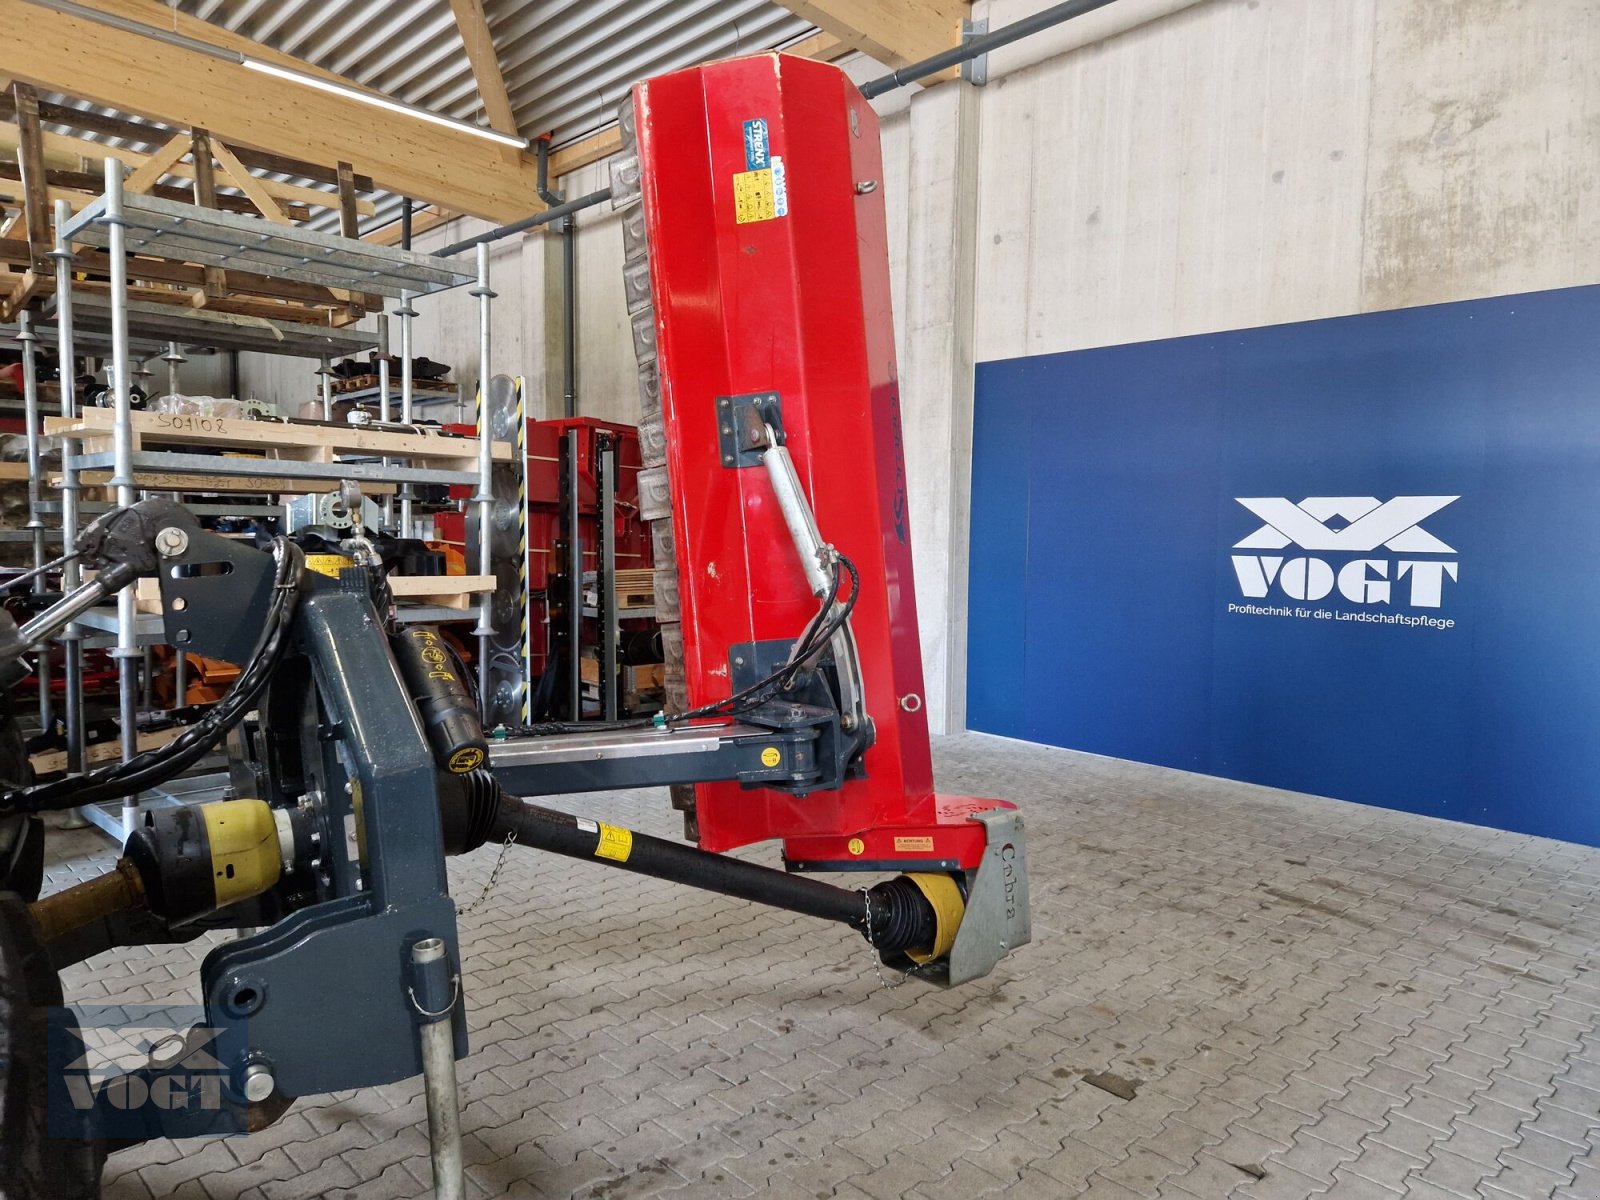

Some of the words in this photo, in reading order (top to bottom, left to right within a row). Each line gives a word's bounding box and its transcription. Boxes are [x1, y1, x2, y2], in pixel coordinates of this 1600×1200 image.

[752, 121, 765, 164] STRENX
[1231, 555, 1459, 608] VOGT
[1228, 603, 1292, 617] Profitechnik
[1295, 608, 1312, 618] für
[1314, 610, 1333, 620] die
[1335, 610, 1455, 630] Landschaftspflege
